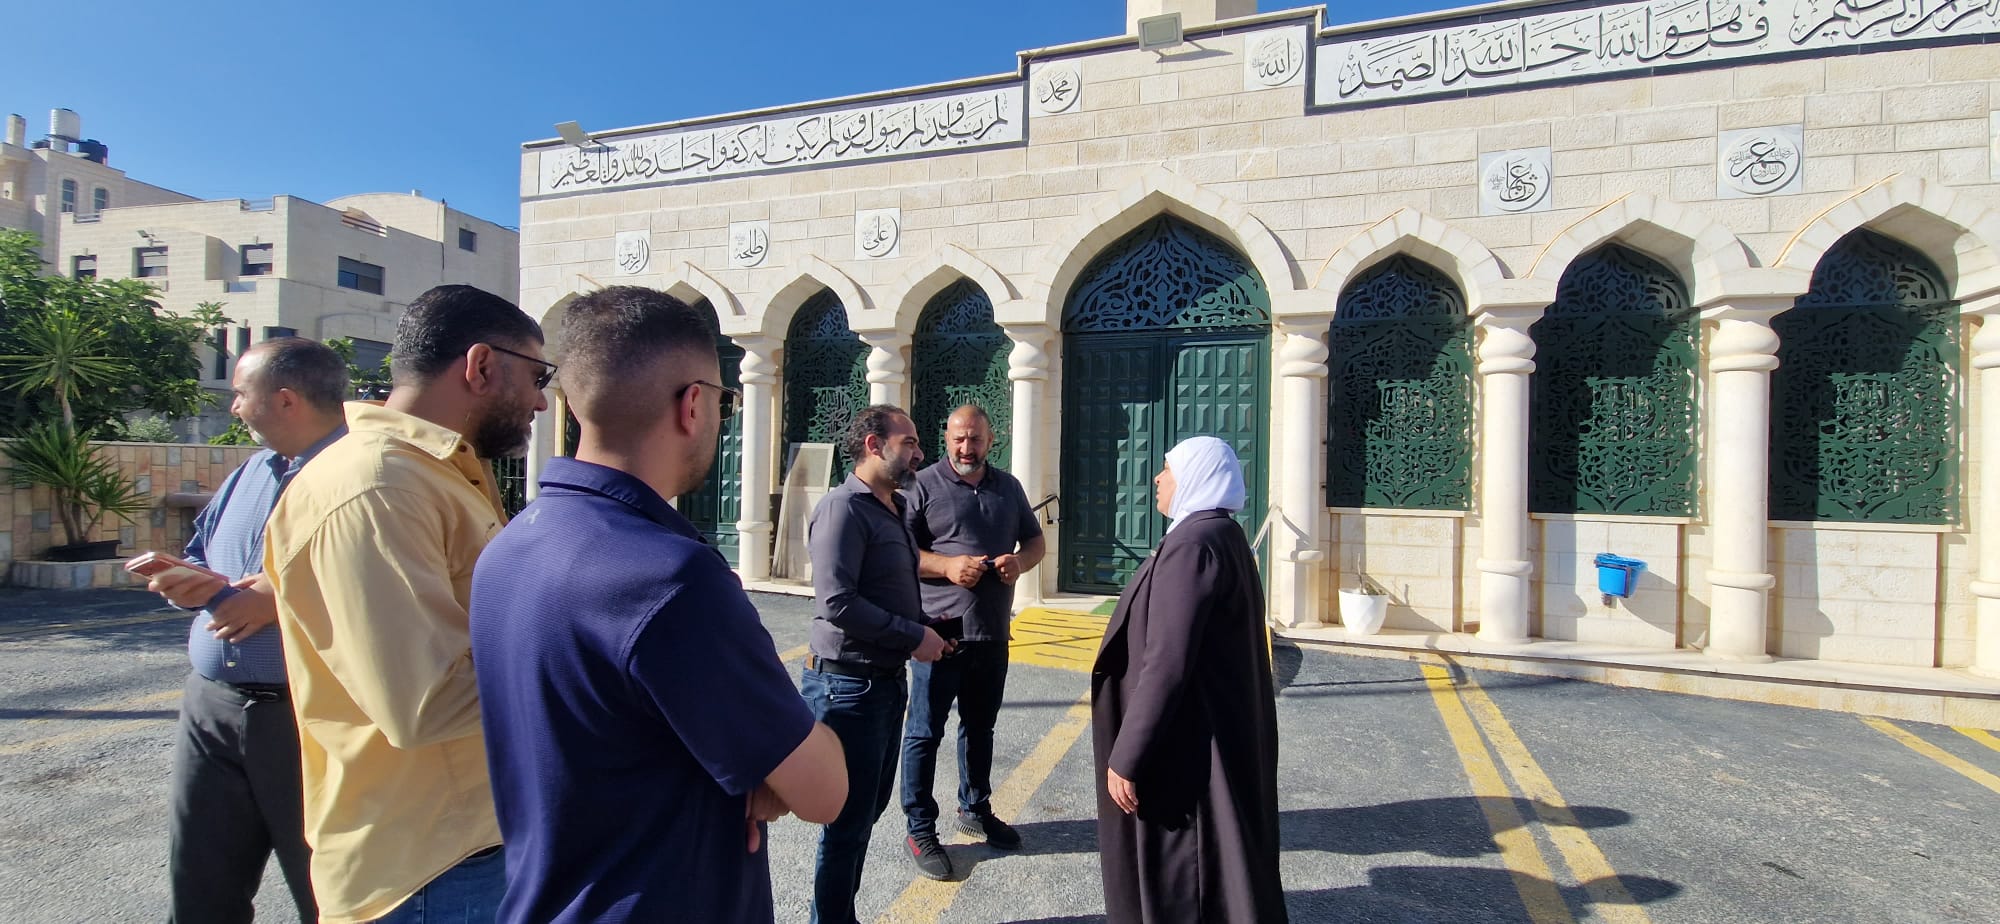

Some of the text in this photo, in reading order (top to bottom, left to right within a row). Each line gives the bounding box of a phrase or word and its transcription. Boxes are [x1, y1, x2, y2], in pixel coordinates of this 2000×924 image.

[1596, 5, 1651, 62] الله
[1258, 38, 1291, 78] الله
[1339, 34, 1448, 98] الصمد
[1040, 79, 1073, 103] محمد
